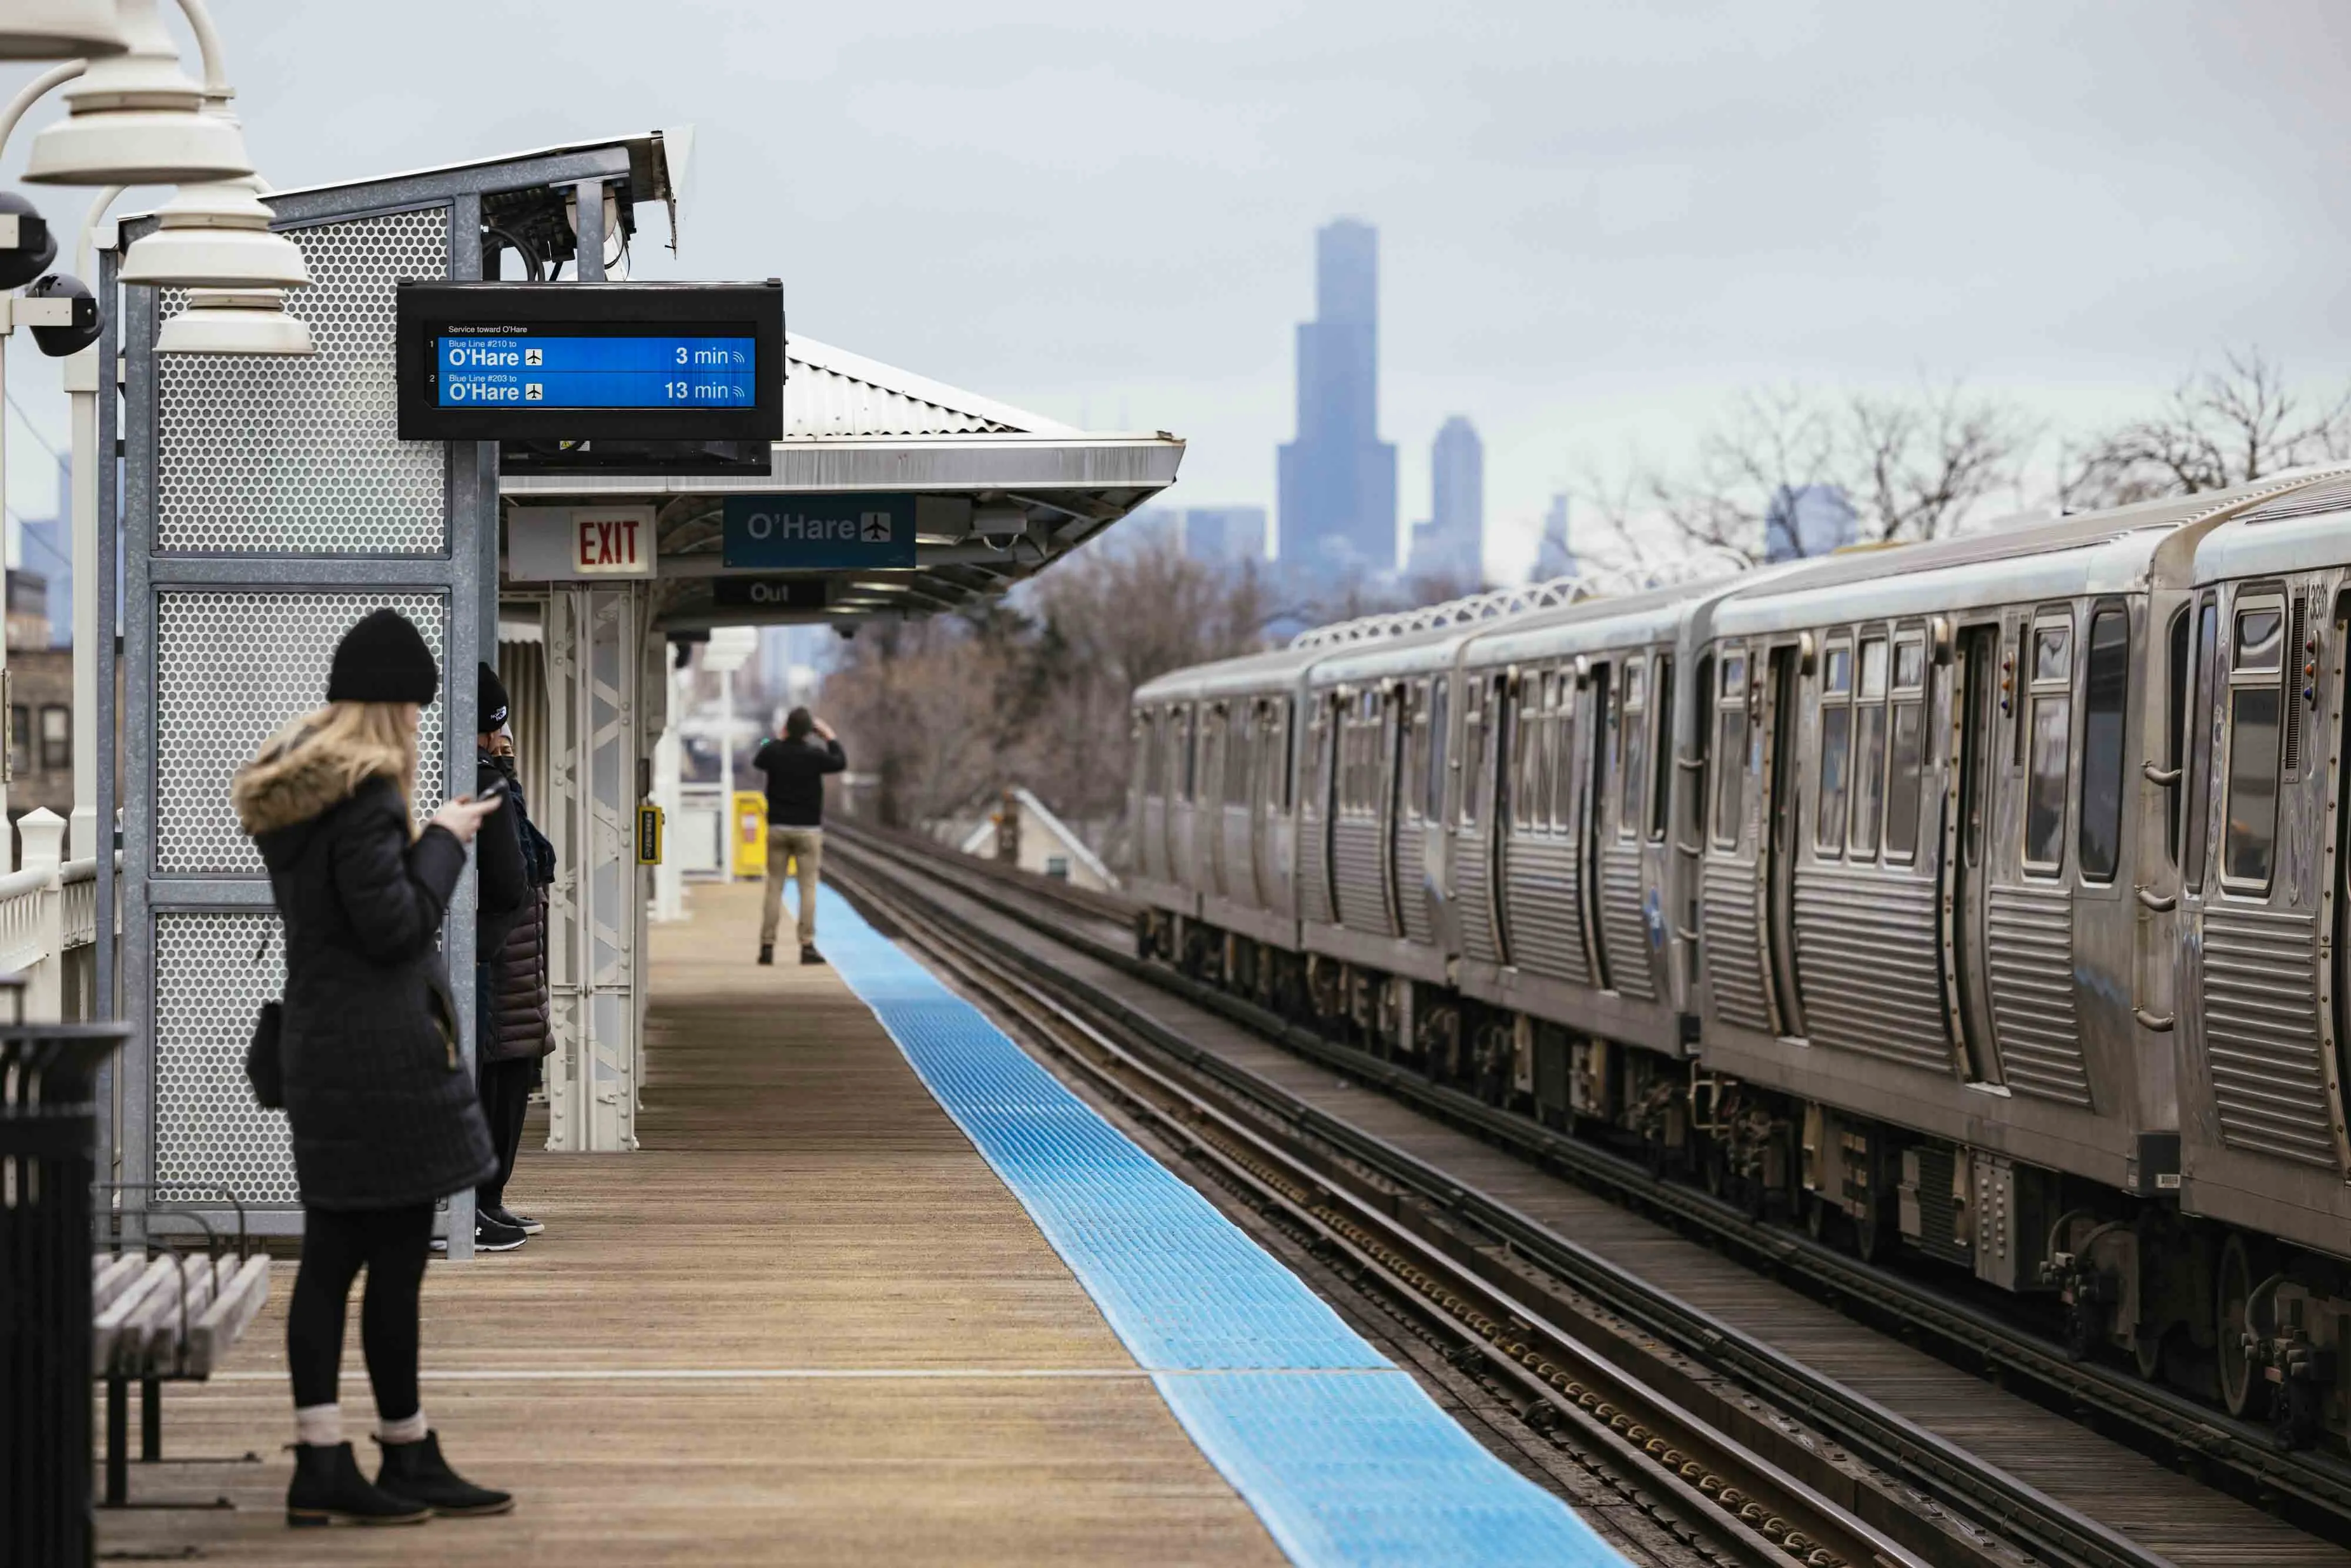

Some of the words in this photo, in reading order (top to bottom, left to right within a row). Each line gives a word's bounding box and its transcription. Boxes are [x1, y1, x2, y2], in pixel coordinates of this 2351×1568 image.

[448, 340, 466, 348] Blue
[469, 340, 485, 348] Line
[487, 340, 507, 348] #210
[449, 348, 519, 366] O'Hare
[676, 347, 688, 365] 3
[695, 347, 728, 364] min
[429, 374, 436, 383] 2
[450, 383, 520, 400] O'Hare
[665, 381, 688, 399] 13
[695, 381, 728, 398] min
[747, 512, 856, 540] O’Hare
[580, 521, 639, 564] EXIT
[750, 582, 789, 602] Out
